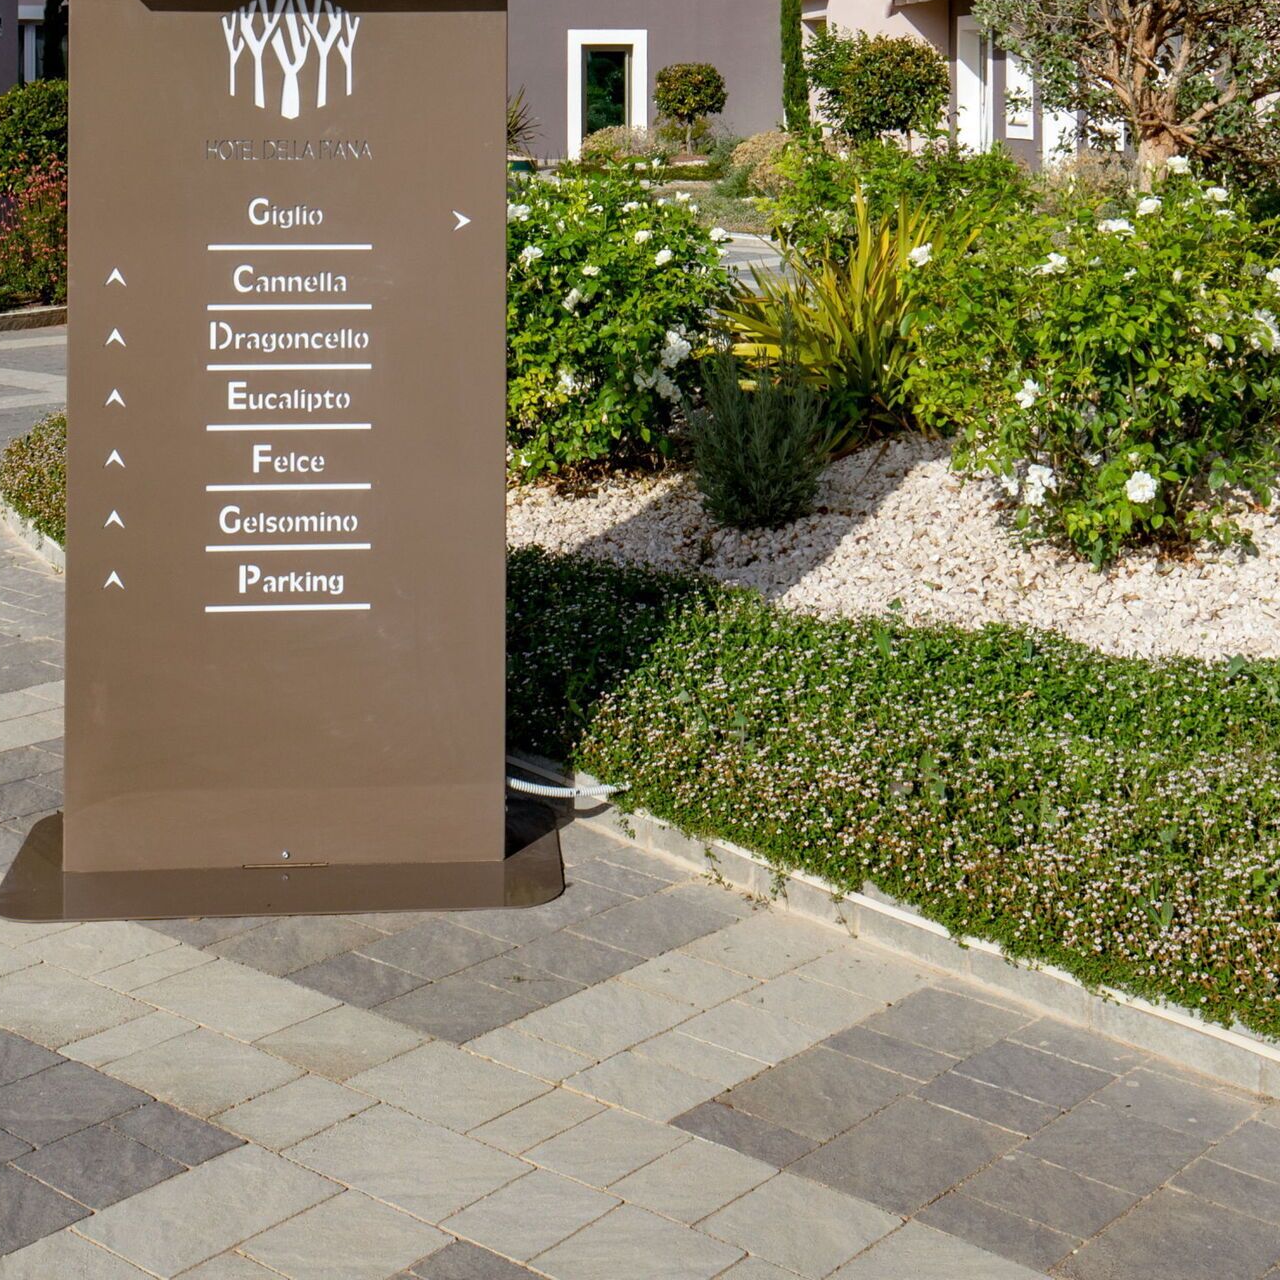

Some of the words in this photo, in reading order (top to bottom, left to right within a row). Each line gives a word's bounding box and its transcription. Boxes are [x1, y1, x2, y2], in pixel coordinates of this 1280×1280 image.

[205, 139, 259, 161] HOTEL
[263, 139, 315, 161] DELLA
[319, 139, 373, 161] PIANA
[247, 197, 324, 228] Giglio
[233, 265, 347, 294] Cannella
[209, 321, 369, 353] Dragoncello
[228, 381, 351, 412] Eucalipto
[253, 445, 325, 474] Felce
[219, 505, 358, 534] Gelsomino
[238, 564, 345, 595] Parking
